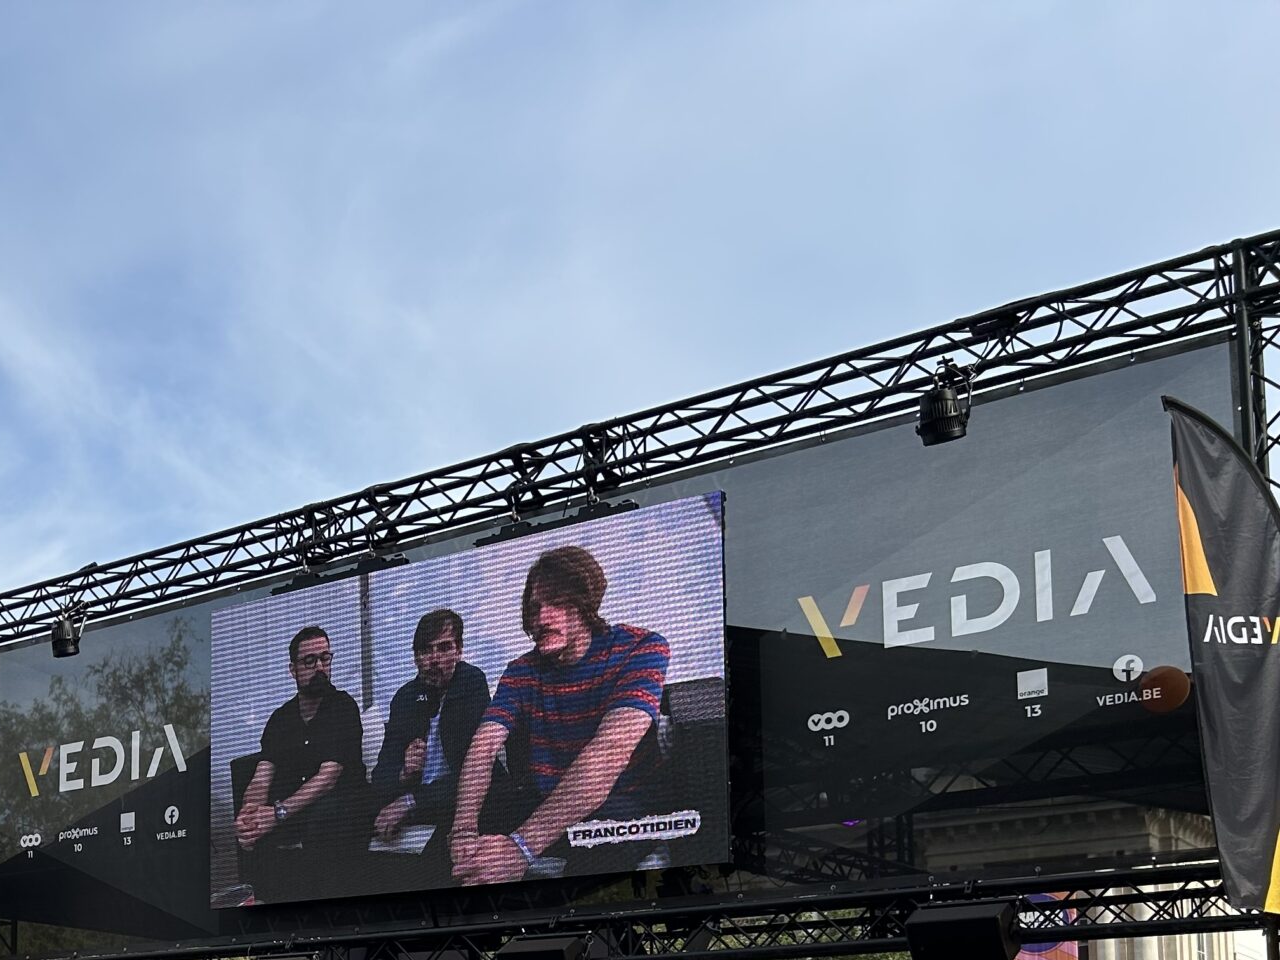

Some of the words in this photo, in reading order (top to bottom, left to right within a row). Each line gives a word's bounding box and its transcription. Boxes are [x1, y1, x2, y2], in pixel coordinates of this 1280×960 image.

[797, 535, 1157, 658] VEDIA
[1096, 687, 1162, 707] VEDIA.BE
[887, 694, 970, 721] proximus
[1024, 704, 1042, 718] 13
[920, 720, 937, 733] 10
[823, 735, 835, 747] 11
[18, 723, 187, 797] VEDIA
[58, 826, 99, 842] proximus
[156, 829, 187, 841] VEDIA.BE
[572, 818, 697, 841] FRANCOTIDIEN
[73, 843, 83, 853] 10
[123, 836, 132, 846] 13
[27, 851, 34, 859] 11
